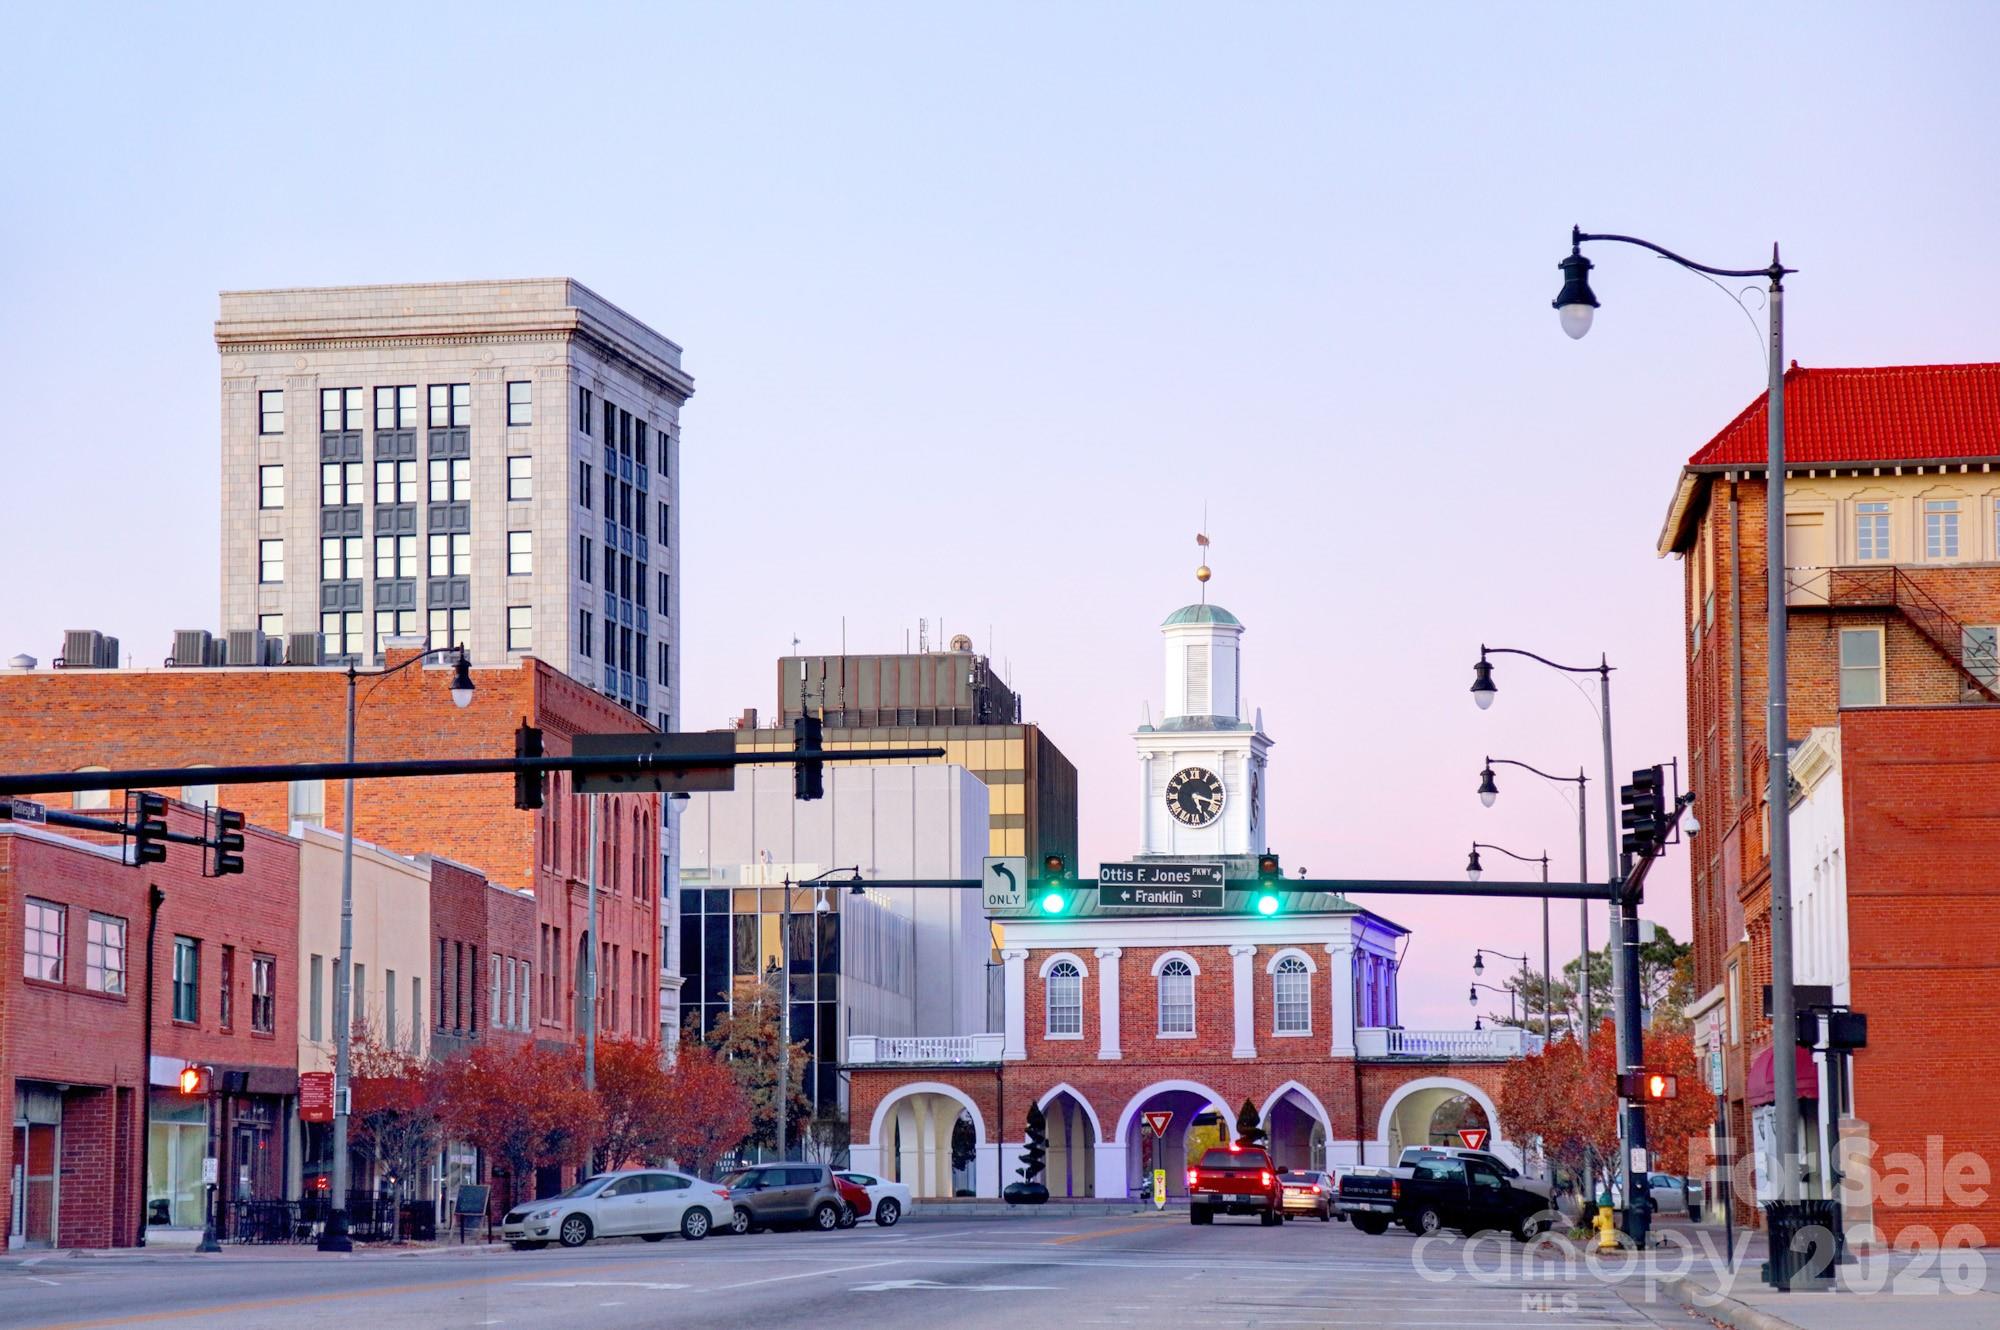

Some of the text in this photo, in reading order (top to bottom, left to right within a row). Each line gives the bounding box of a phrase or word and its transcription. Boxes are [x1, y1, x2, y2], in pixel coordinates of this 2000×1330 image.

[1101, 868, 1212, 882] Ottis F. Jones PKWY
[989, 894, 1021, 905] ONLY
[1135, 889, 1202, 903] Franklin ST
